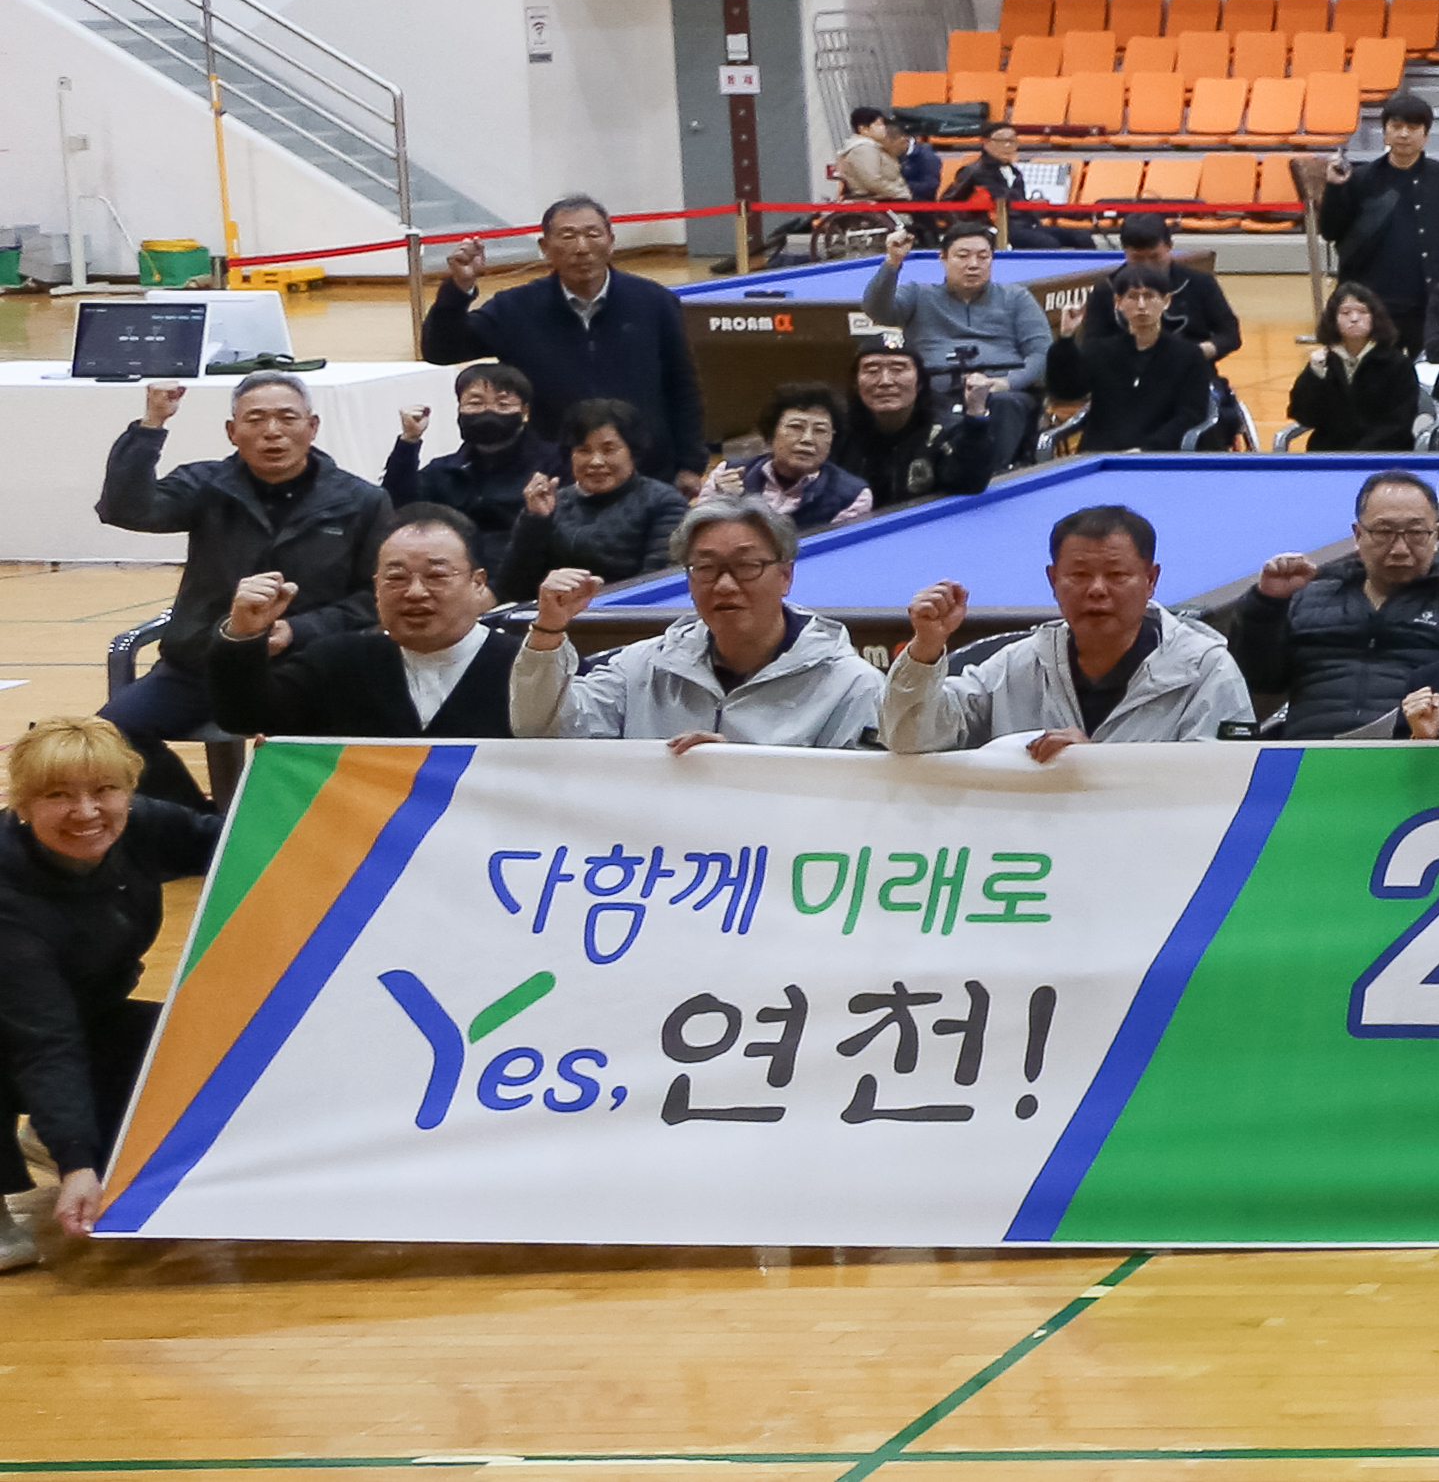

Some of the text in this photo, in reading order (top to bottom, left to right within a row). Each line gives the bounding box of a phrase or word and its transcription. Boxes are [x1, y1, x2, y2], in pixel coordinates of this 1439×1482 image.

[487, 845, 1053, 965] 다함께 미래로
[377, 968, 629, 1132] Yes,
